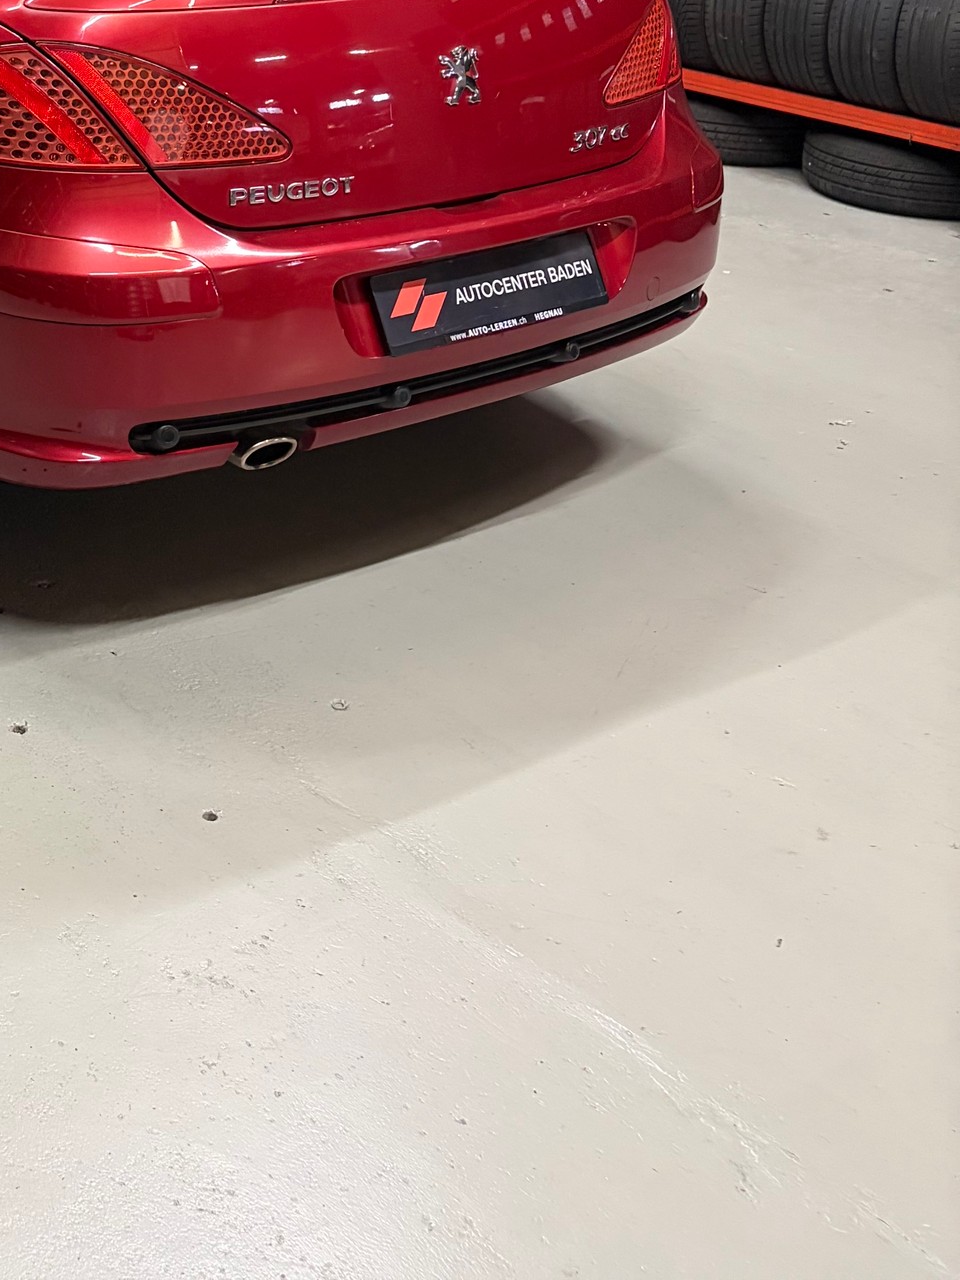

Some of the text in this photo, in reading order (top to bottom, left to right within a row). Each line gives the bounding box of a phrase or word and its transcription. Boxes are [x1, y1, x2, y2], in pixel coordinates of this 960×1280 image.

[569, 125, 608, 152] 307
[229, 175, 355, 207] PEUGEOT
[455, 258, 593, 305] AUTOCENTER BADEN
[450, 307, 563, 341] www.AUTO-LERZEN.ch HEGNAU
